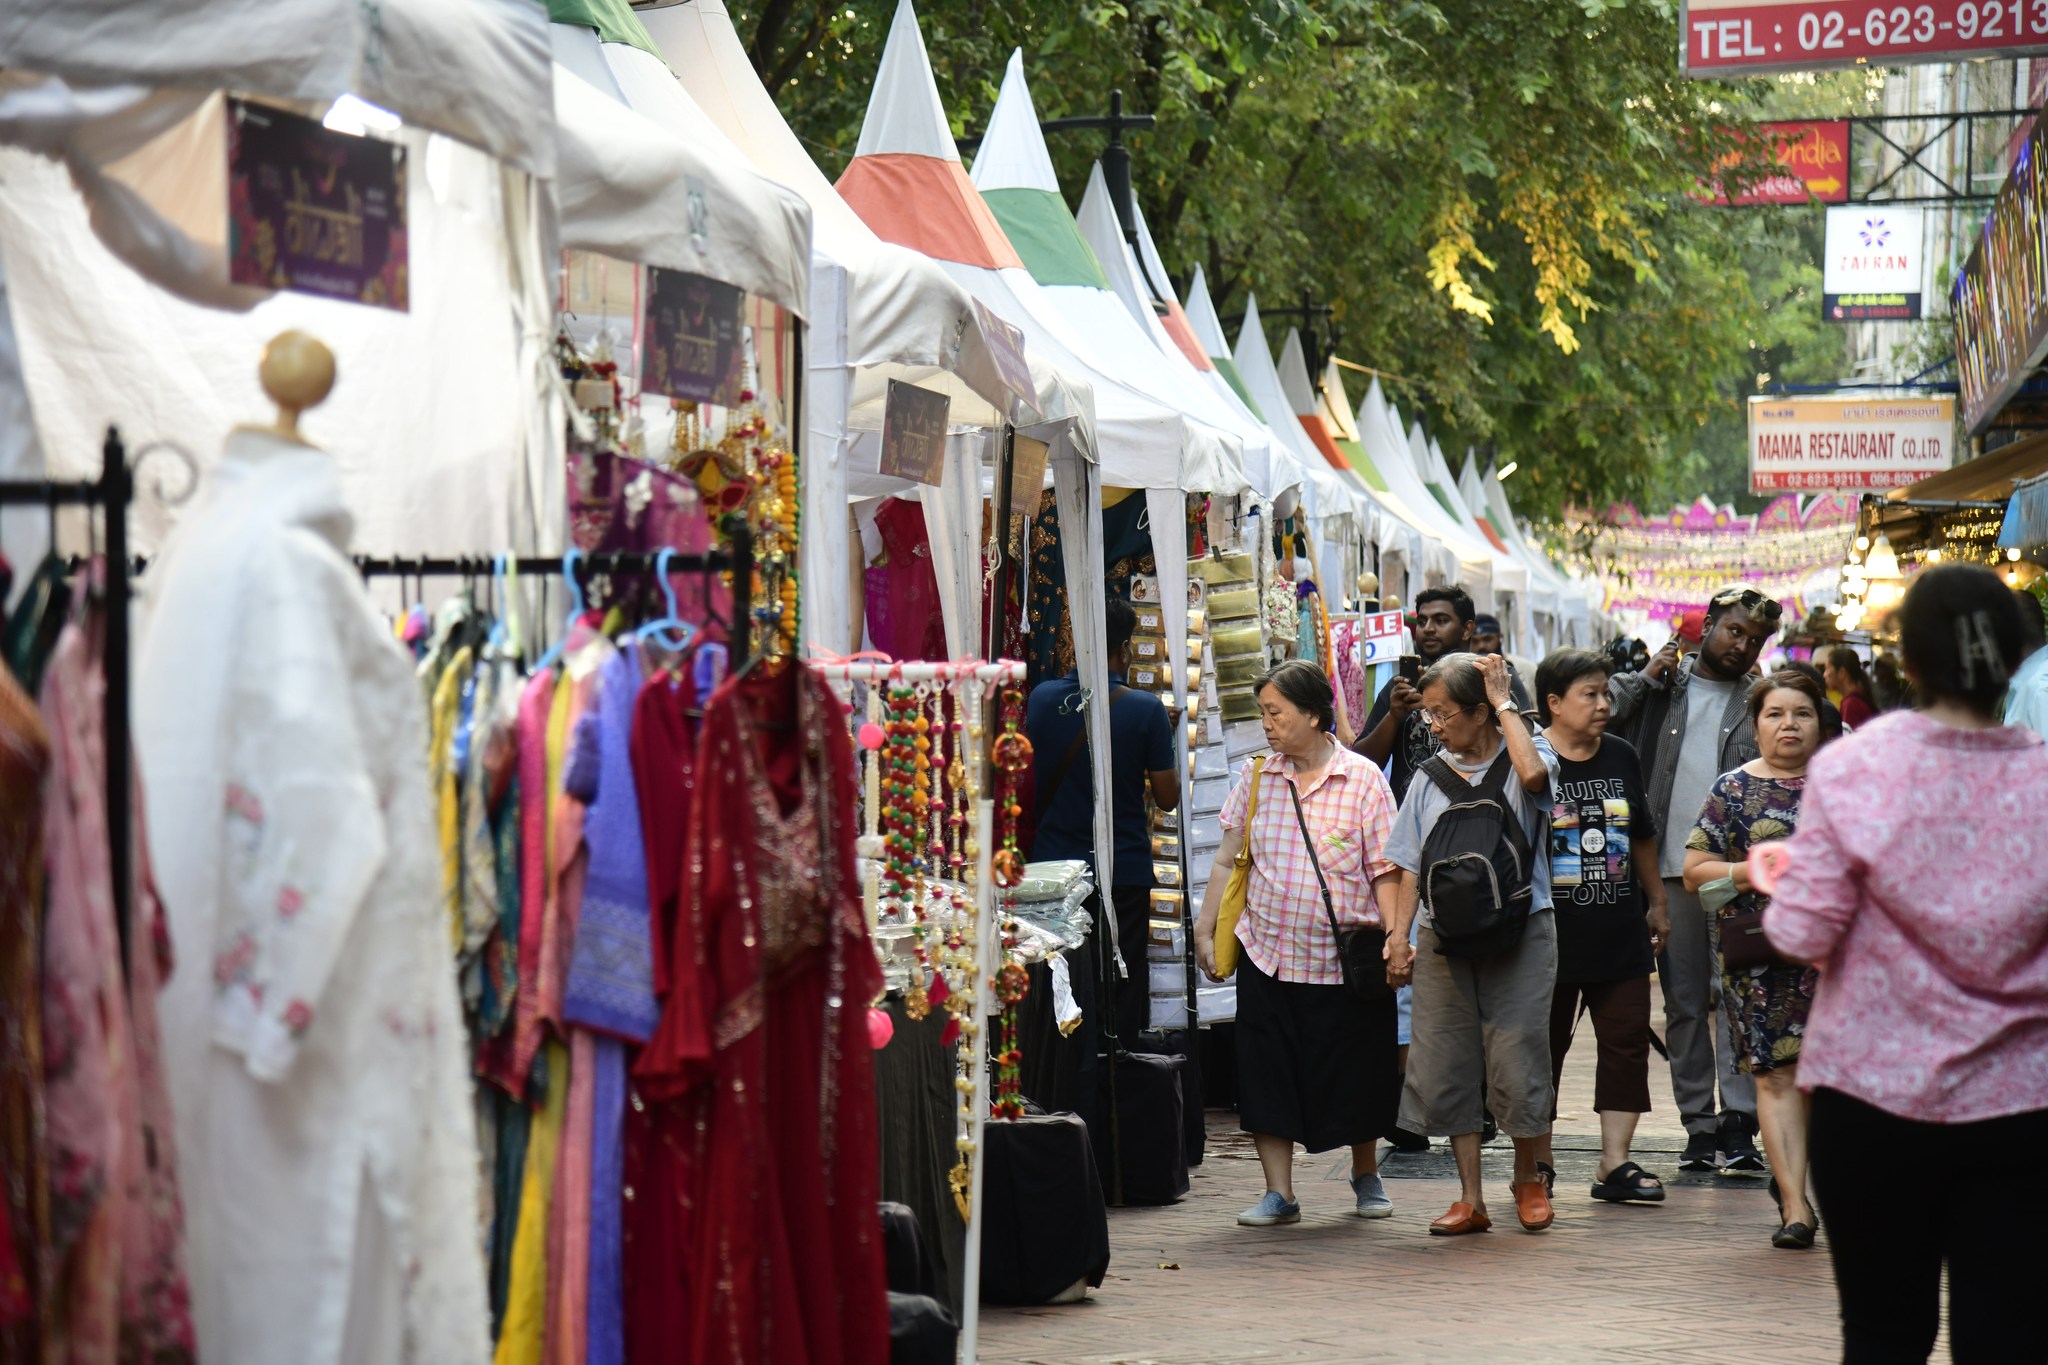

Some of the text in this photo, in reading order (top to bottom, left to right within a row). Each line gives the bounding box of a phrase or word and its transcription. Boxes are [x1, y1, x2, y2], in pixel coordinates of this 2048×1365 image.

[1798, 0, 2048, 51] 02-623-9213
[1758, 433, 1803, 461] MAMA
[1809, 432, 1895, 460] RESTAURANT
[1583, 836, 1604, 846] VIBES
[1583, 871, 1607, 881] LAND
